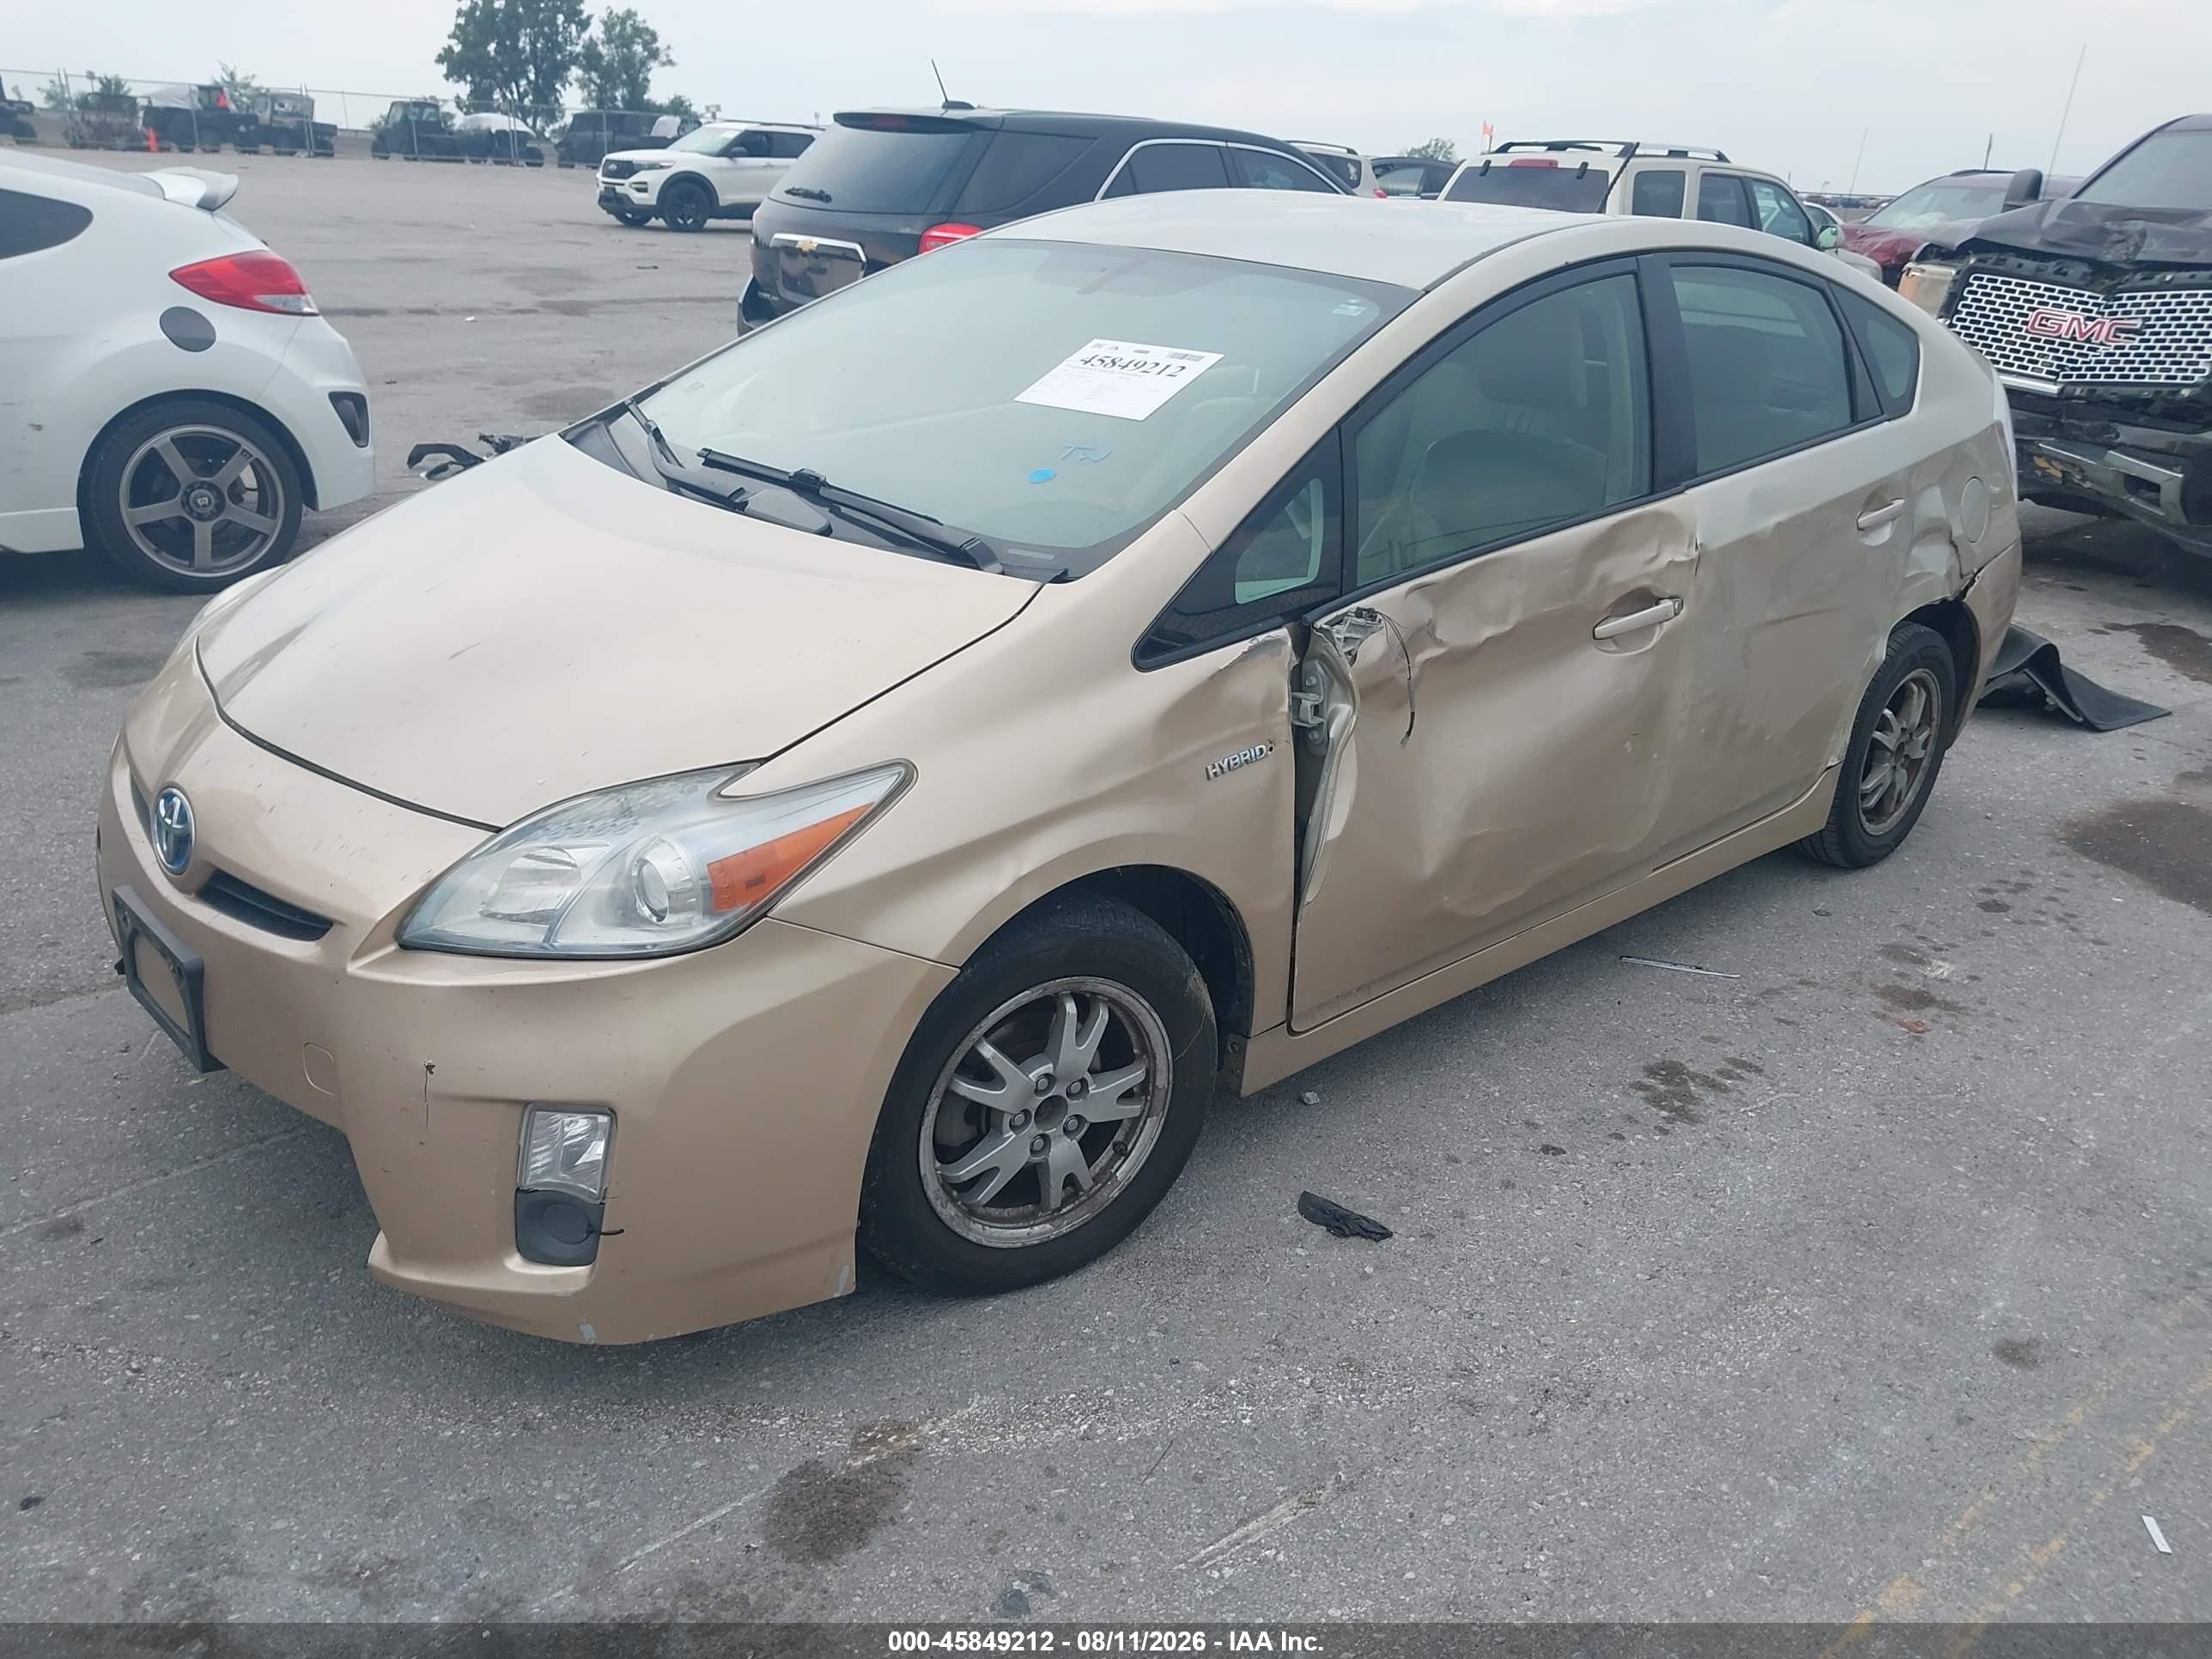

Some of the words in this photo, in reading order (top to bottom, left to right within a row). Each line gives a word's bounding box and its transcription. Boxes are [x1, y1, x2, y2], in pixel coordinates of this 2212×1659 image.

[2027, 309, 2142, 345] GMC
[1079, 353, 1187, 378] 45849212
[1206, 744, 1267, 781] HYBRID
